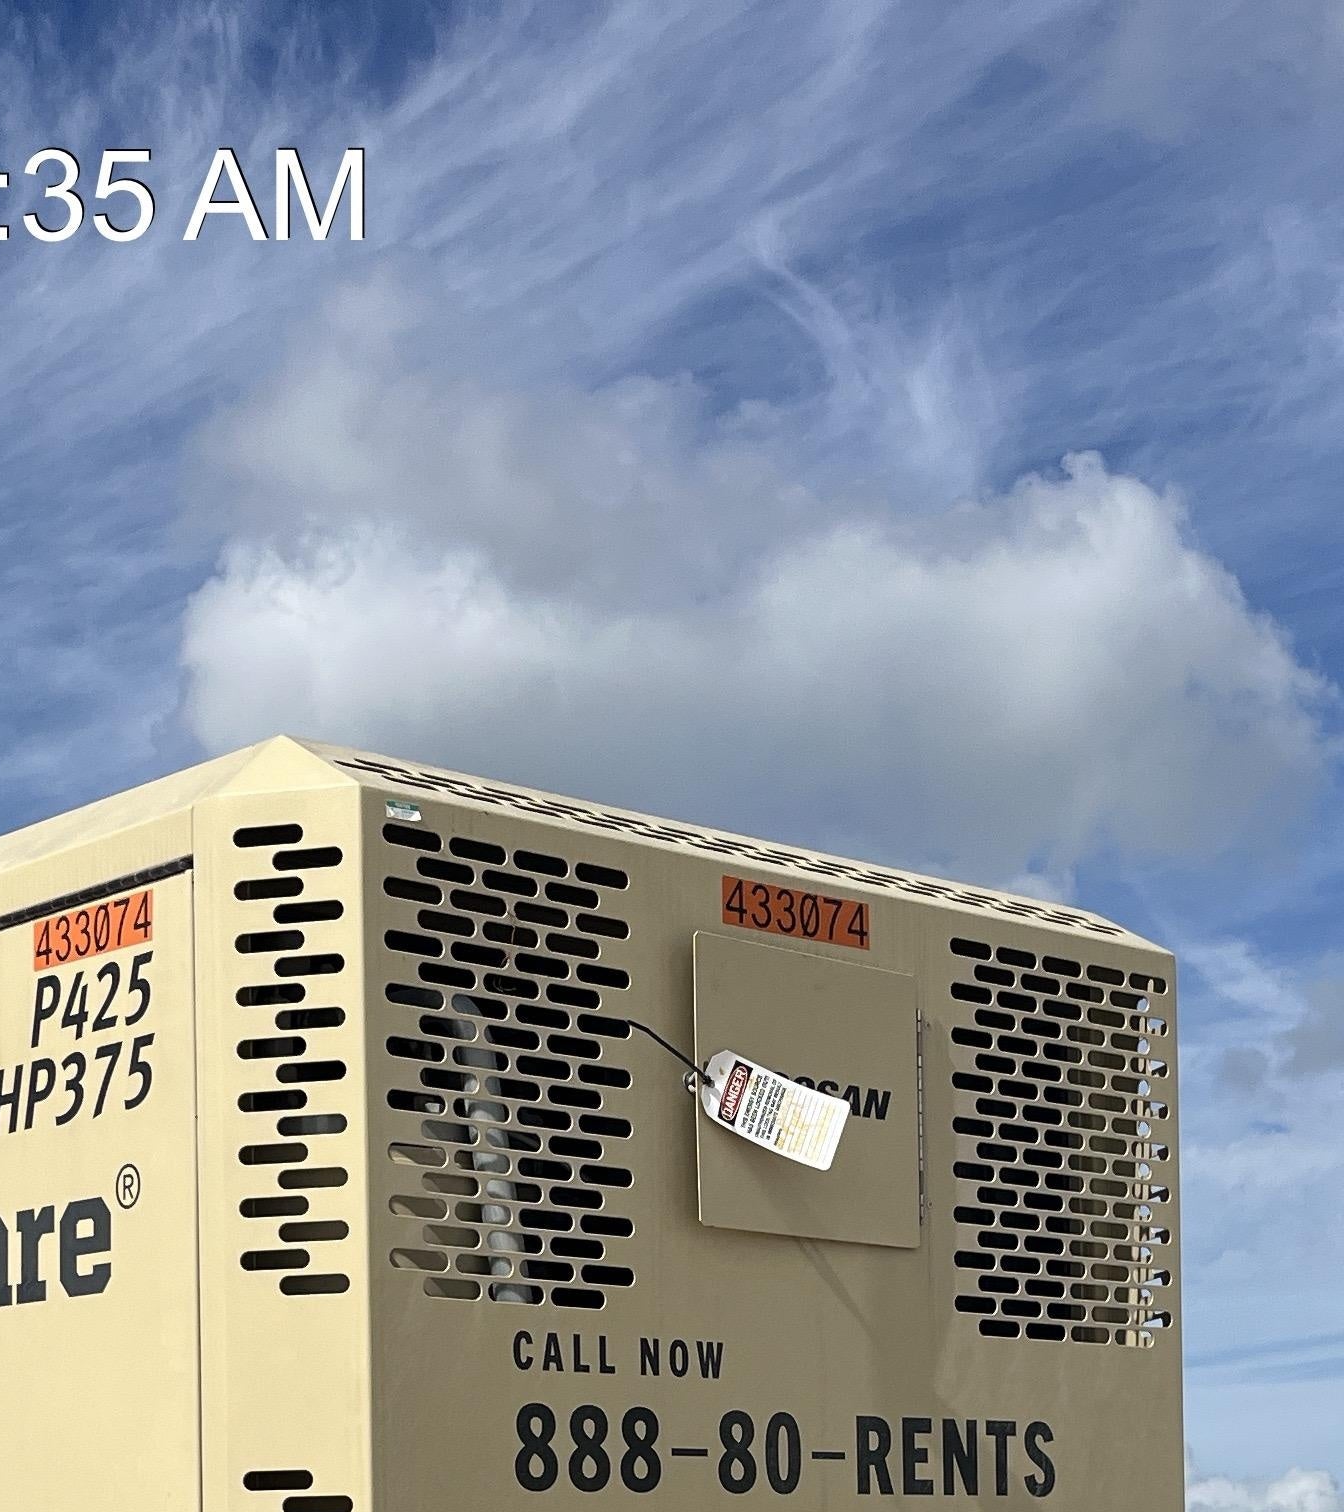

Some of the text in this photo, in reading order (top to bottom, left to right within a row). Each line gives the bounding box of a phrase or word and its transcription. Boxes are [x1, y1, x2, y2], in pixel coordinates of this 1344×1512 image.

[35, 895, 153, 967] 433074
[724, 878, 870, 950] 433074
[30, 950, 155, 1050] P425
[722, 1068, 748, 1120] DANGER
[512, 1330, 725, 1381] CALL NOW
[513, 1401, 1058, 1499] 888-80-RENTS
